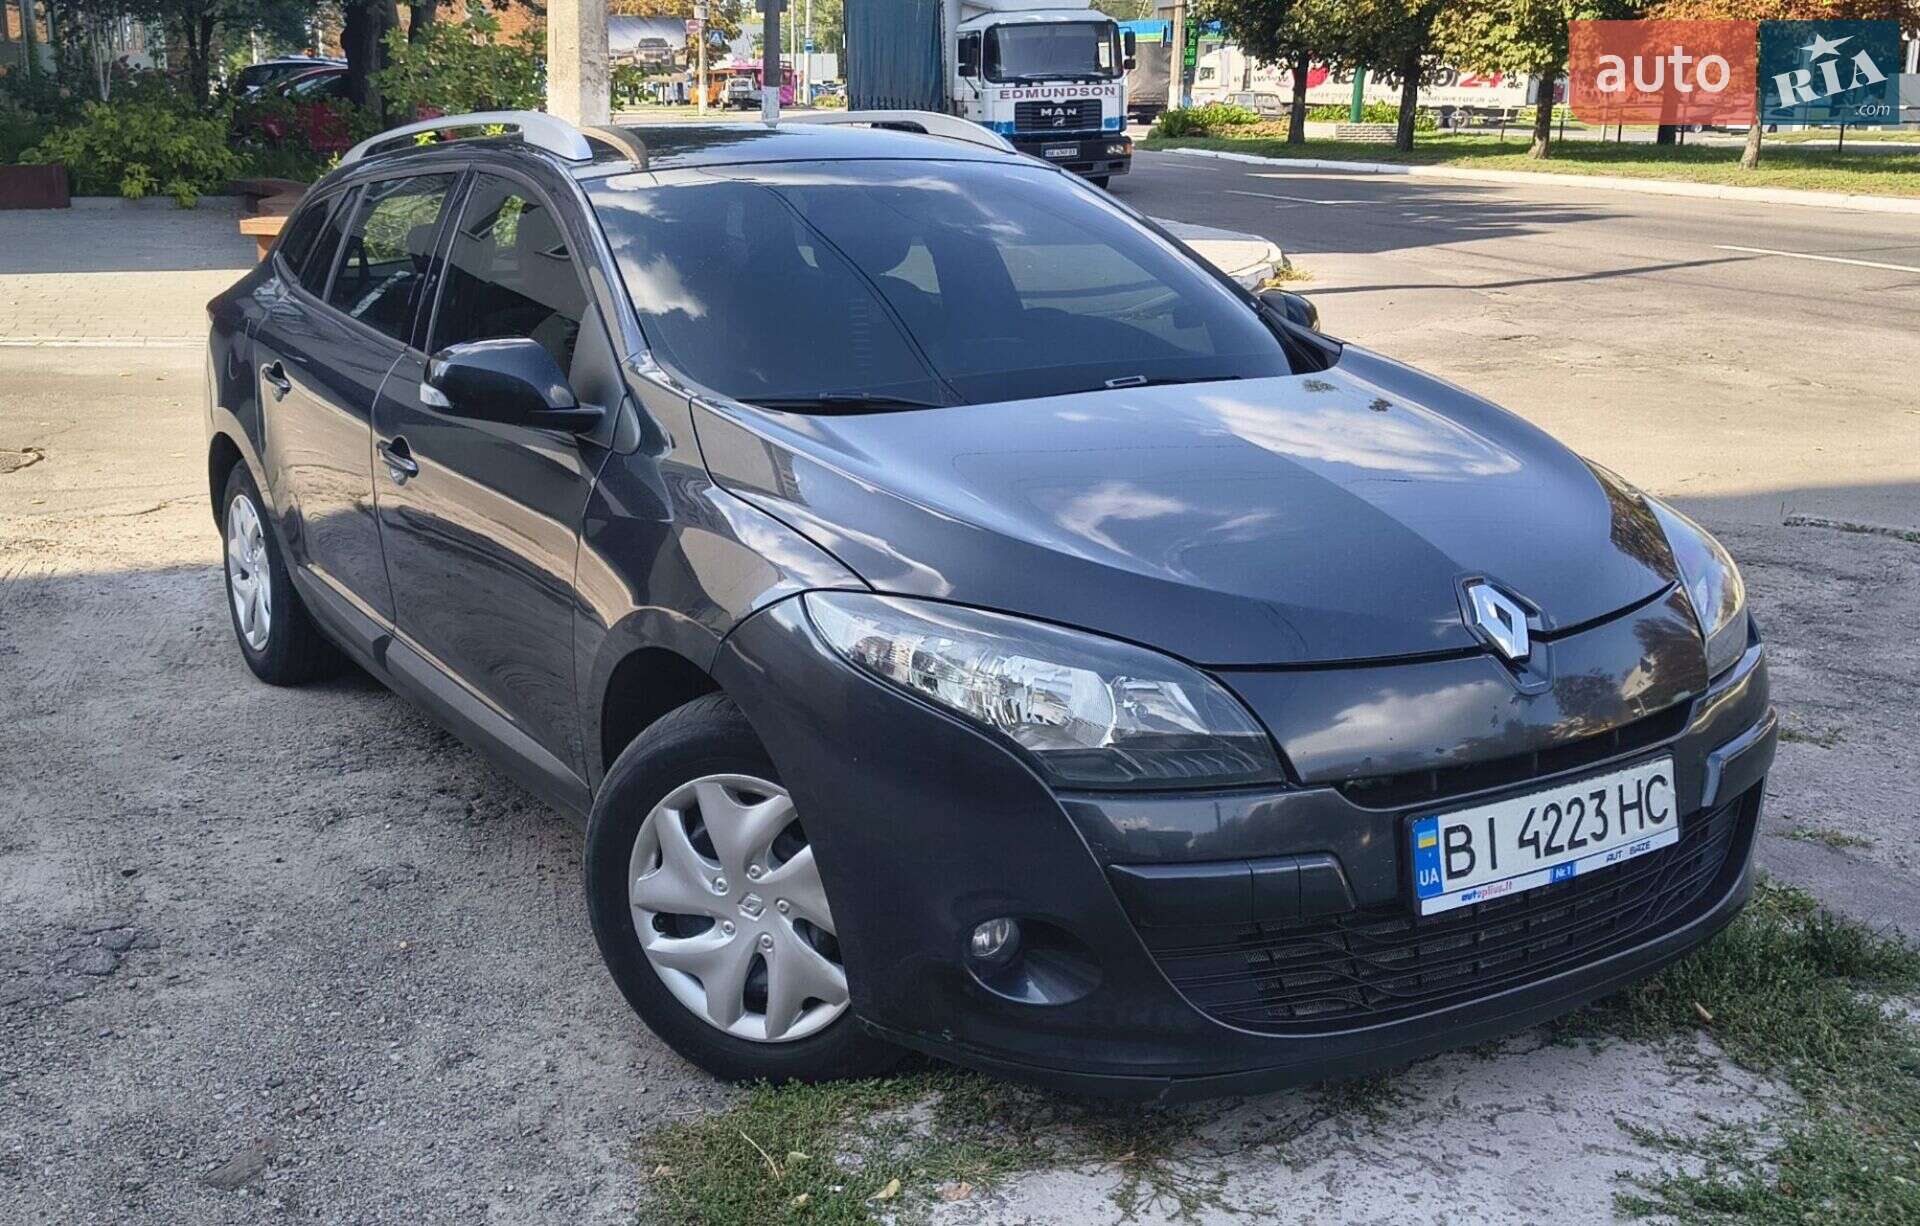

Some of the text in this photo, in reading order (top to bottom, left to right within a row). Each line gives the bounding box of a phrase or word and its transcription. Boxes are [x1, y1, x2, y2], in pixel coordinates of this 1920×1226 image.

[999, 86, 1116, 100] EDMUNDSON
[1040, 107, 1077, 117] MAN
[1443, 774, 1669, 880] BI 4223 HC
[1418, 867, 1440, 886] UA
